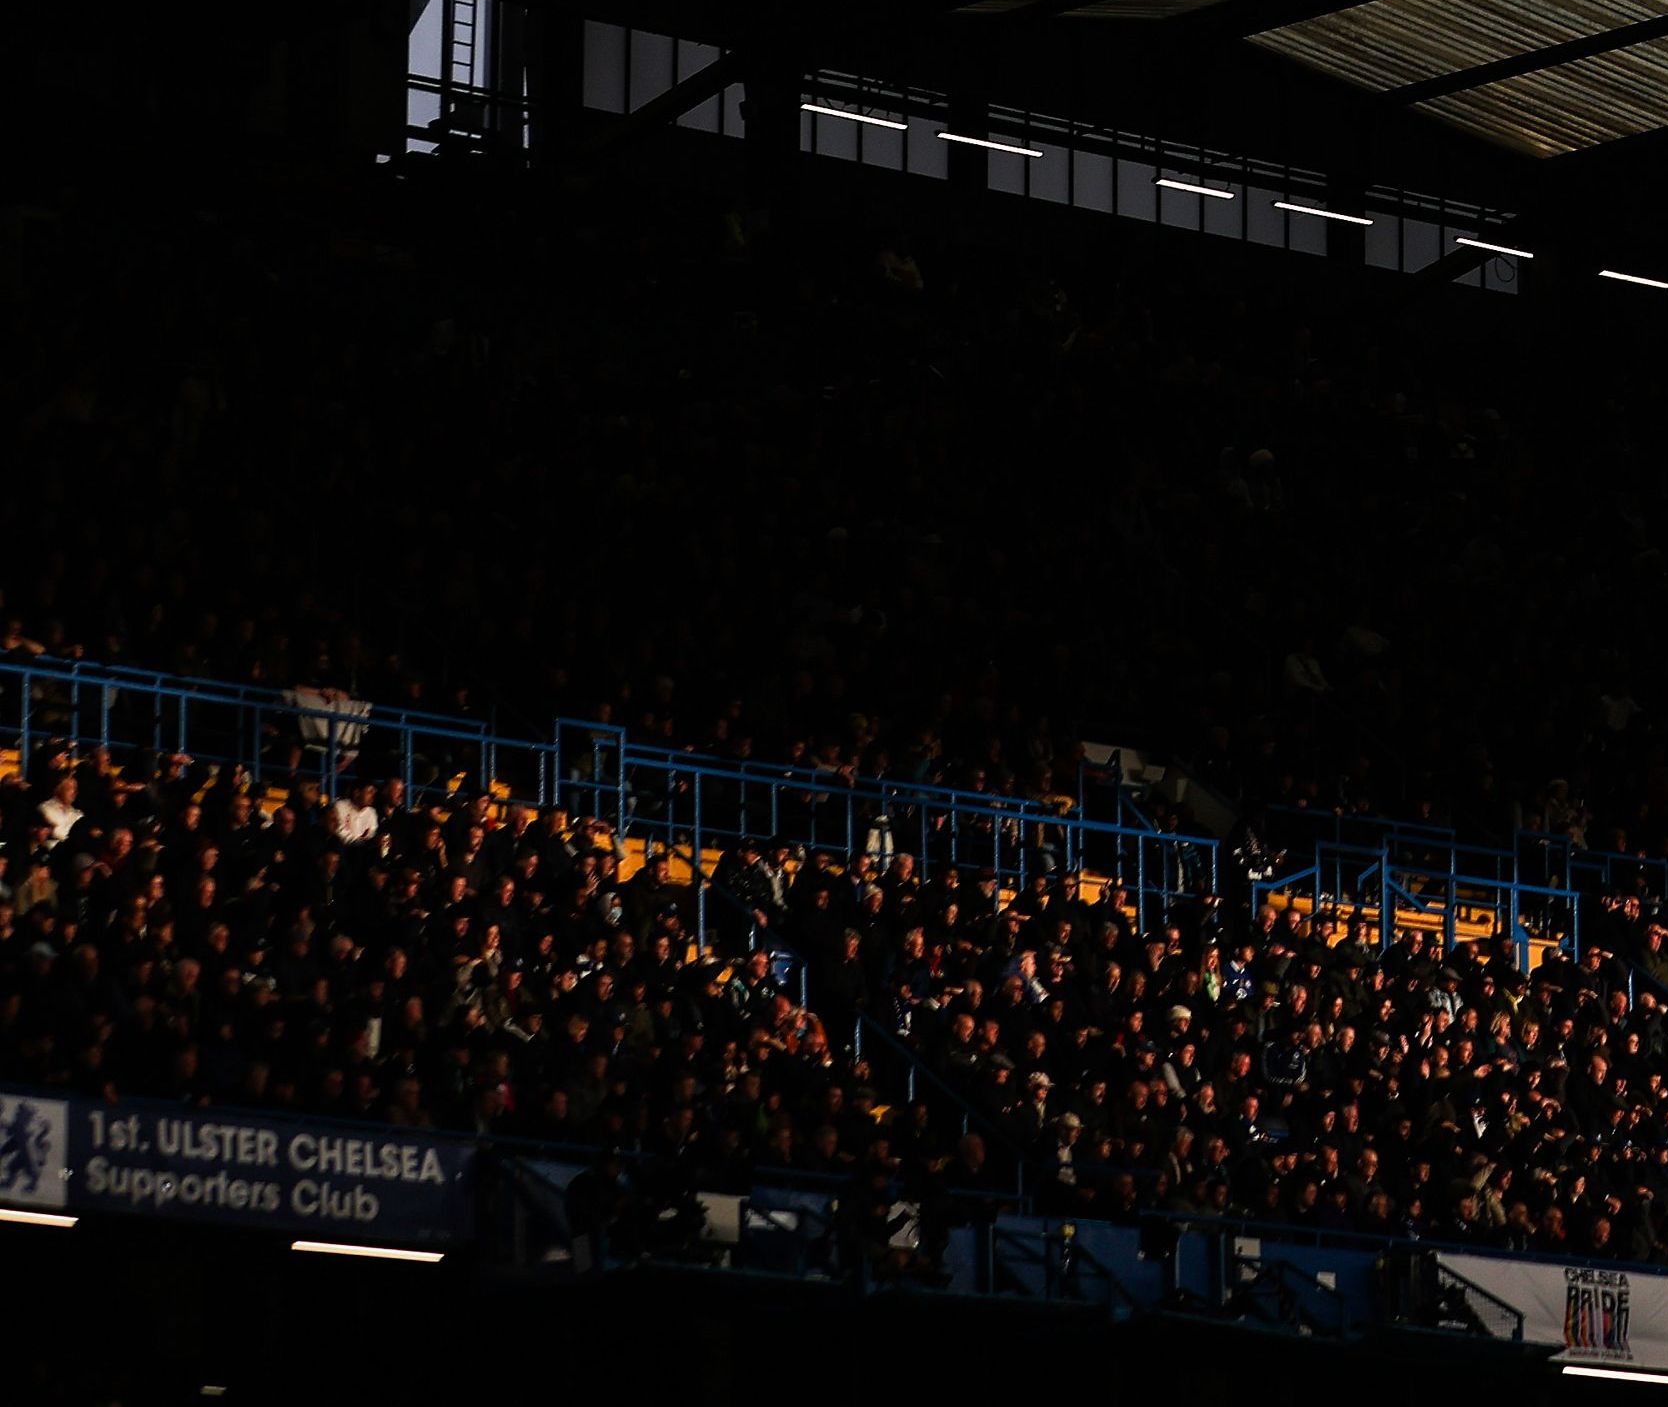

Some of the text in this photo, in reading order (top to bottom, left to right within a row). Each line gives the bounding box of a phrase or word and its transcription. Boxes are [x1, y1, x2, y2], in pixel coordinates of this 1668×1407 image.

[87, 1110, 445, 1185] 1st. ULSTER CHELSEA
[85, 1155, 381, 1224] Supporters Club
